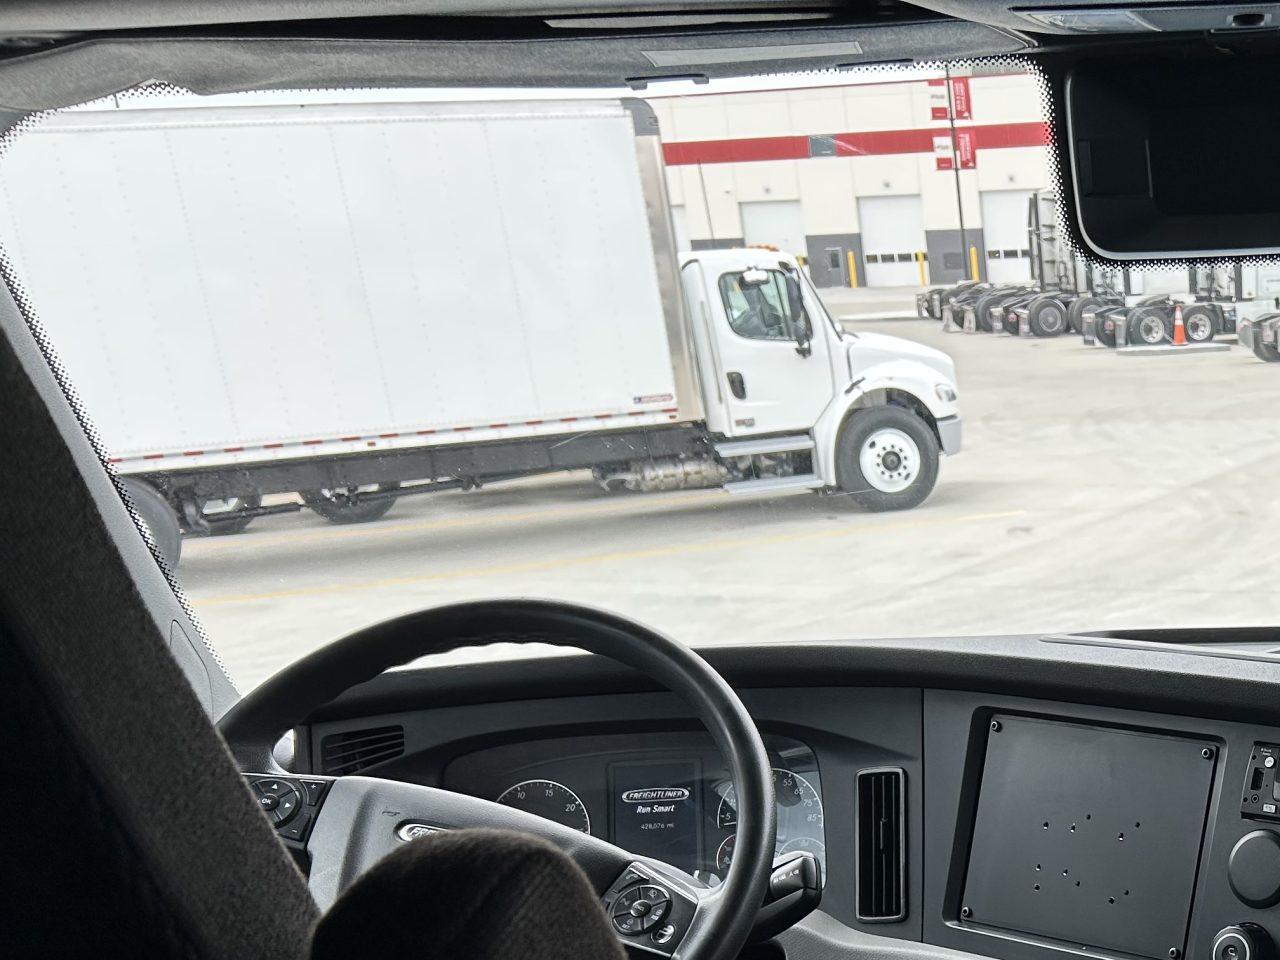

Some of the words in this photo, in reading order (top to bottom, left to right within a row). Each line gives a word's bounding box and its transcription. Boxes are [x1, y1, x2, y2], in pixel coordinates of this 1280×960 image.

[783, 779, 793, 787] 55
[517, 791, 526, 800] 10
[545, 789, 554, 798] 15
[629, 790, 683, 800] FREIGHTLINER
[565, 803, 577, 812] 20
[636, 805, 651, 814] Run
[652, 804, 675, 813] Smart
[807, 814, 816, 822] 85
